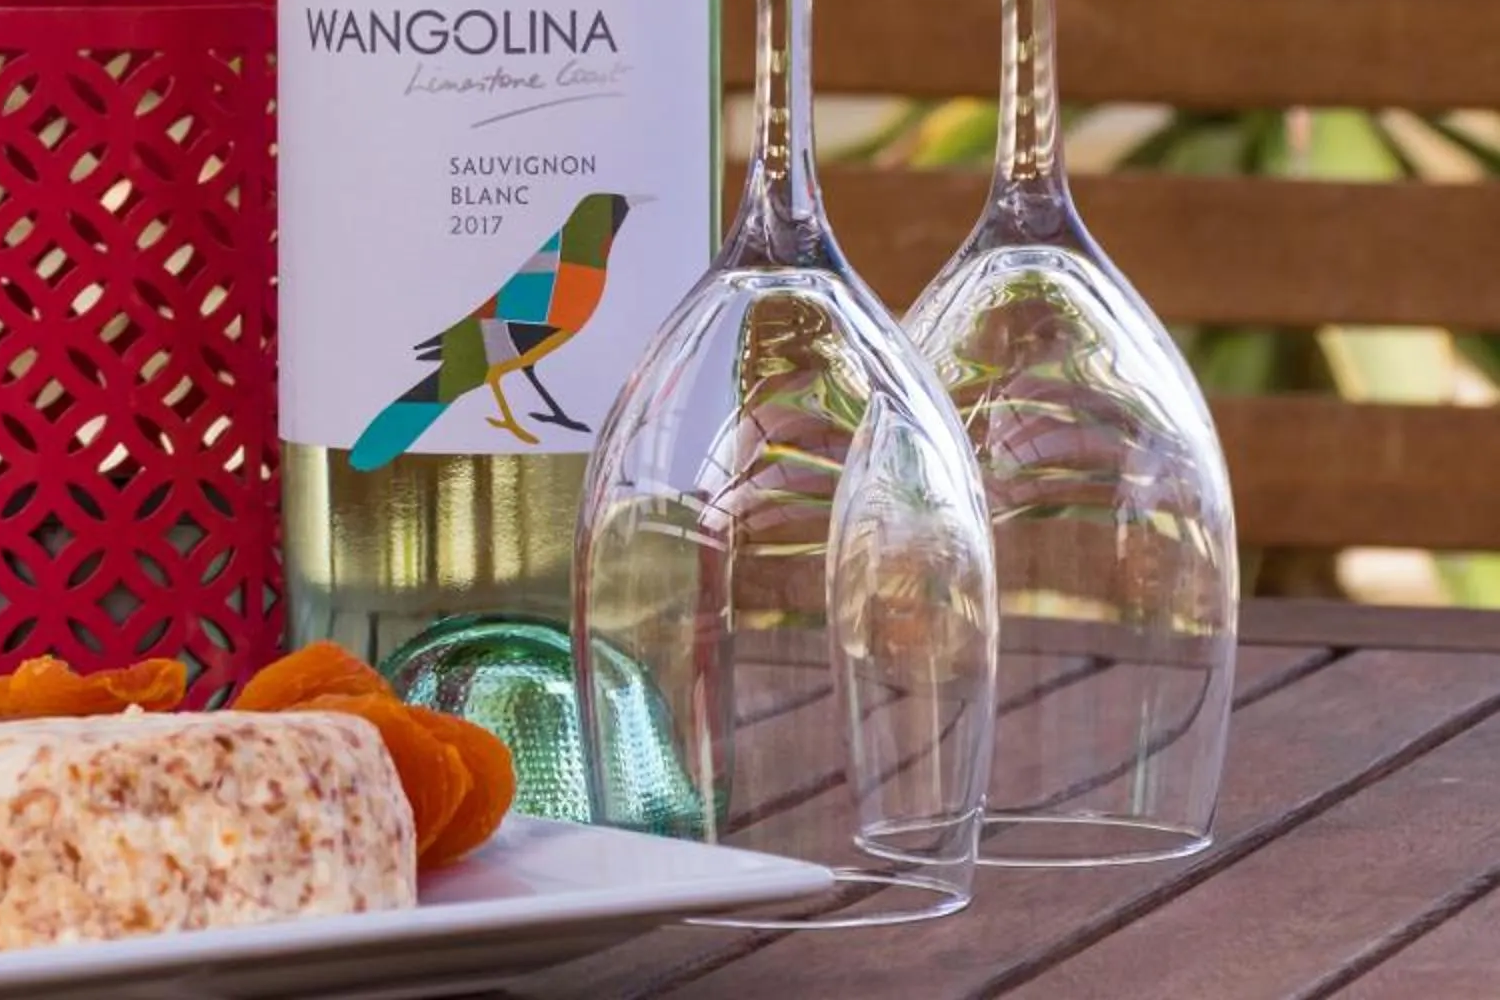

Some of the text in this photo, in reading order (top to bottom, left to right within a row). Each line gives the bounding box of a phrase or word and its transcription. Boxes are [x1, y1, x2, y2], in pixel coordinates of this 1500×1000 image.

[306, 7, 619, 55] WANGOLINA
[403, 60, 547, 96] Limestone
[449, 154, 597, 176] SAUVIGNON
[450, 185, 530, 206] BLANC
[449, 214, 503, 236] 2017
